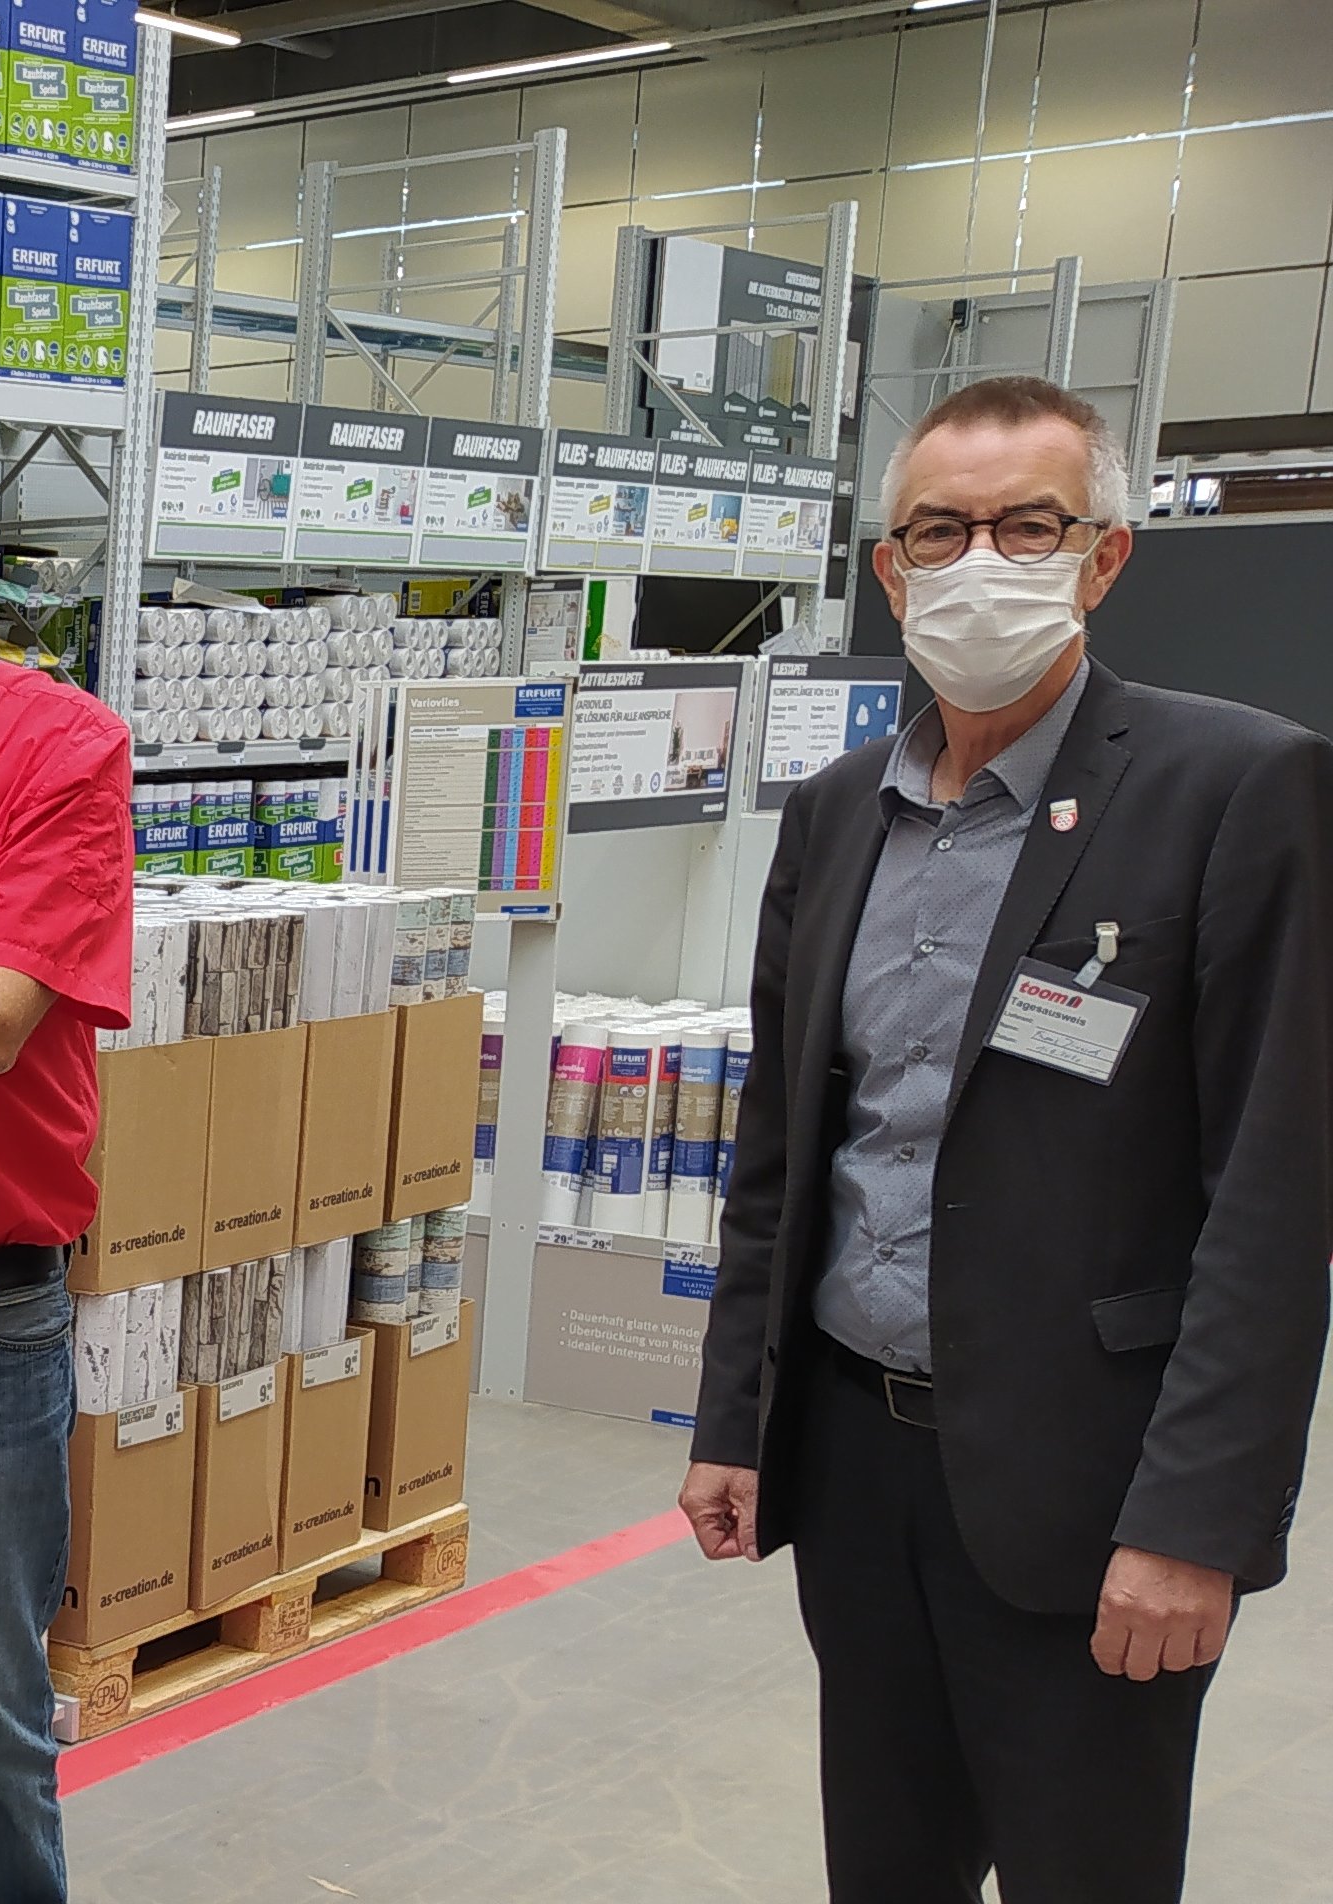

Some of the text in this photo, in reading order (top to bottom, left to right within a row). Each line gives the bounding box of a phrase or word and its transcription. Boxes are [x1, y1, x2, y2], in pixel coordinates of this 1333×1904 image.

[19, 21, 67, 45] ERFURT
[82, 36, 128, 60] ERFURT
[12, 248, 59, 268] ERFURT
[75, 256, 122, 276] ERFURT
[192, 409, 276, 441] RAUHFASER
[330, 422, 405, 451] RAUHFASER
[453, 432, 521, 462] RAUHFASER
[558, 441, 655, 472] VLIES RAUHFASER
[660, 453, 747, 482] VLIES RAUHFASER
[753, 463, 834, 490] VLIES RAUHFASER
[409, 698, 460, 708] Variovlies
[518, 688, 563, 699] ERFURT
[146, 824, 188, 842] ERFURT
[208, 822, 248, 839] ERFURT
[280, 820, 318, 837] ERFURT
[1018, 980, 1067, 1004] toom
[1010, 996, 1087, 1026] Tagesausweis
[402, 1159, 461, 1187] as-creation.de
[309, 1183, 373, 1211] as-creation.de
[214, 1205, 282, 1233] as-creation.de
[109, 1225, 186, 1255] as-creation.de
[569, 1309, 700, 1339] Dauerhaft glatte Wände
[569, 1322, 646, 1347] Überbrückung
[648, 1337, 668, 1348] von
[568, 1338, 690, 1367] Idealer Untergrund für
[397, 1462, 453, 1496] as-creation.de
[293, 1501, 355, 1535] as-creation.de
[211, 1534, 273, 1571] as-creation.de
[100, 1570, 174, 1609] as-creation.de
[96, 1677, 126, 1709] EPAL
